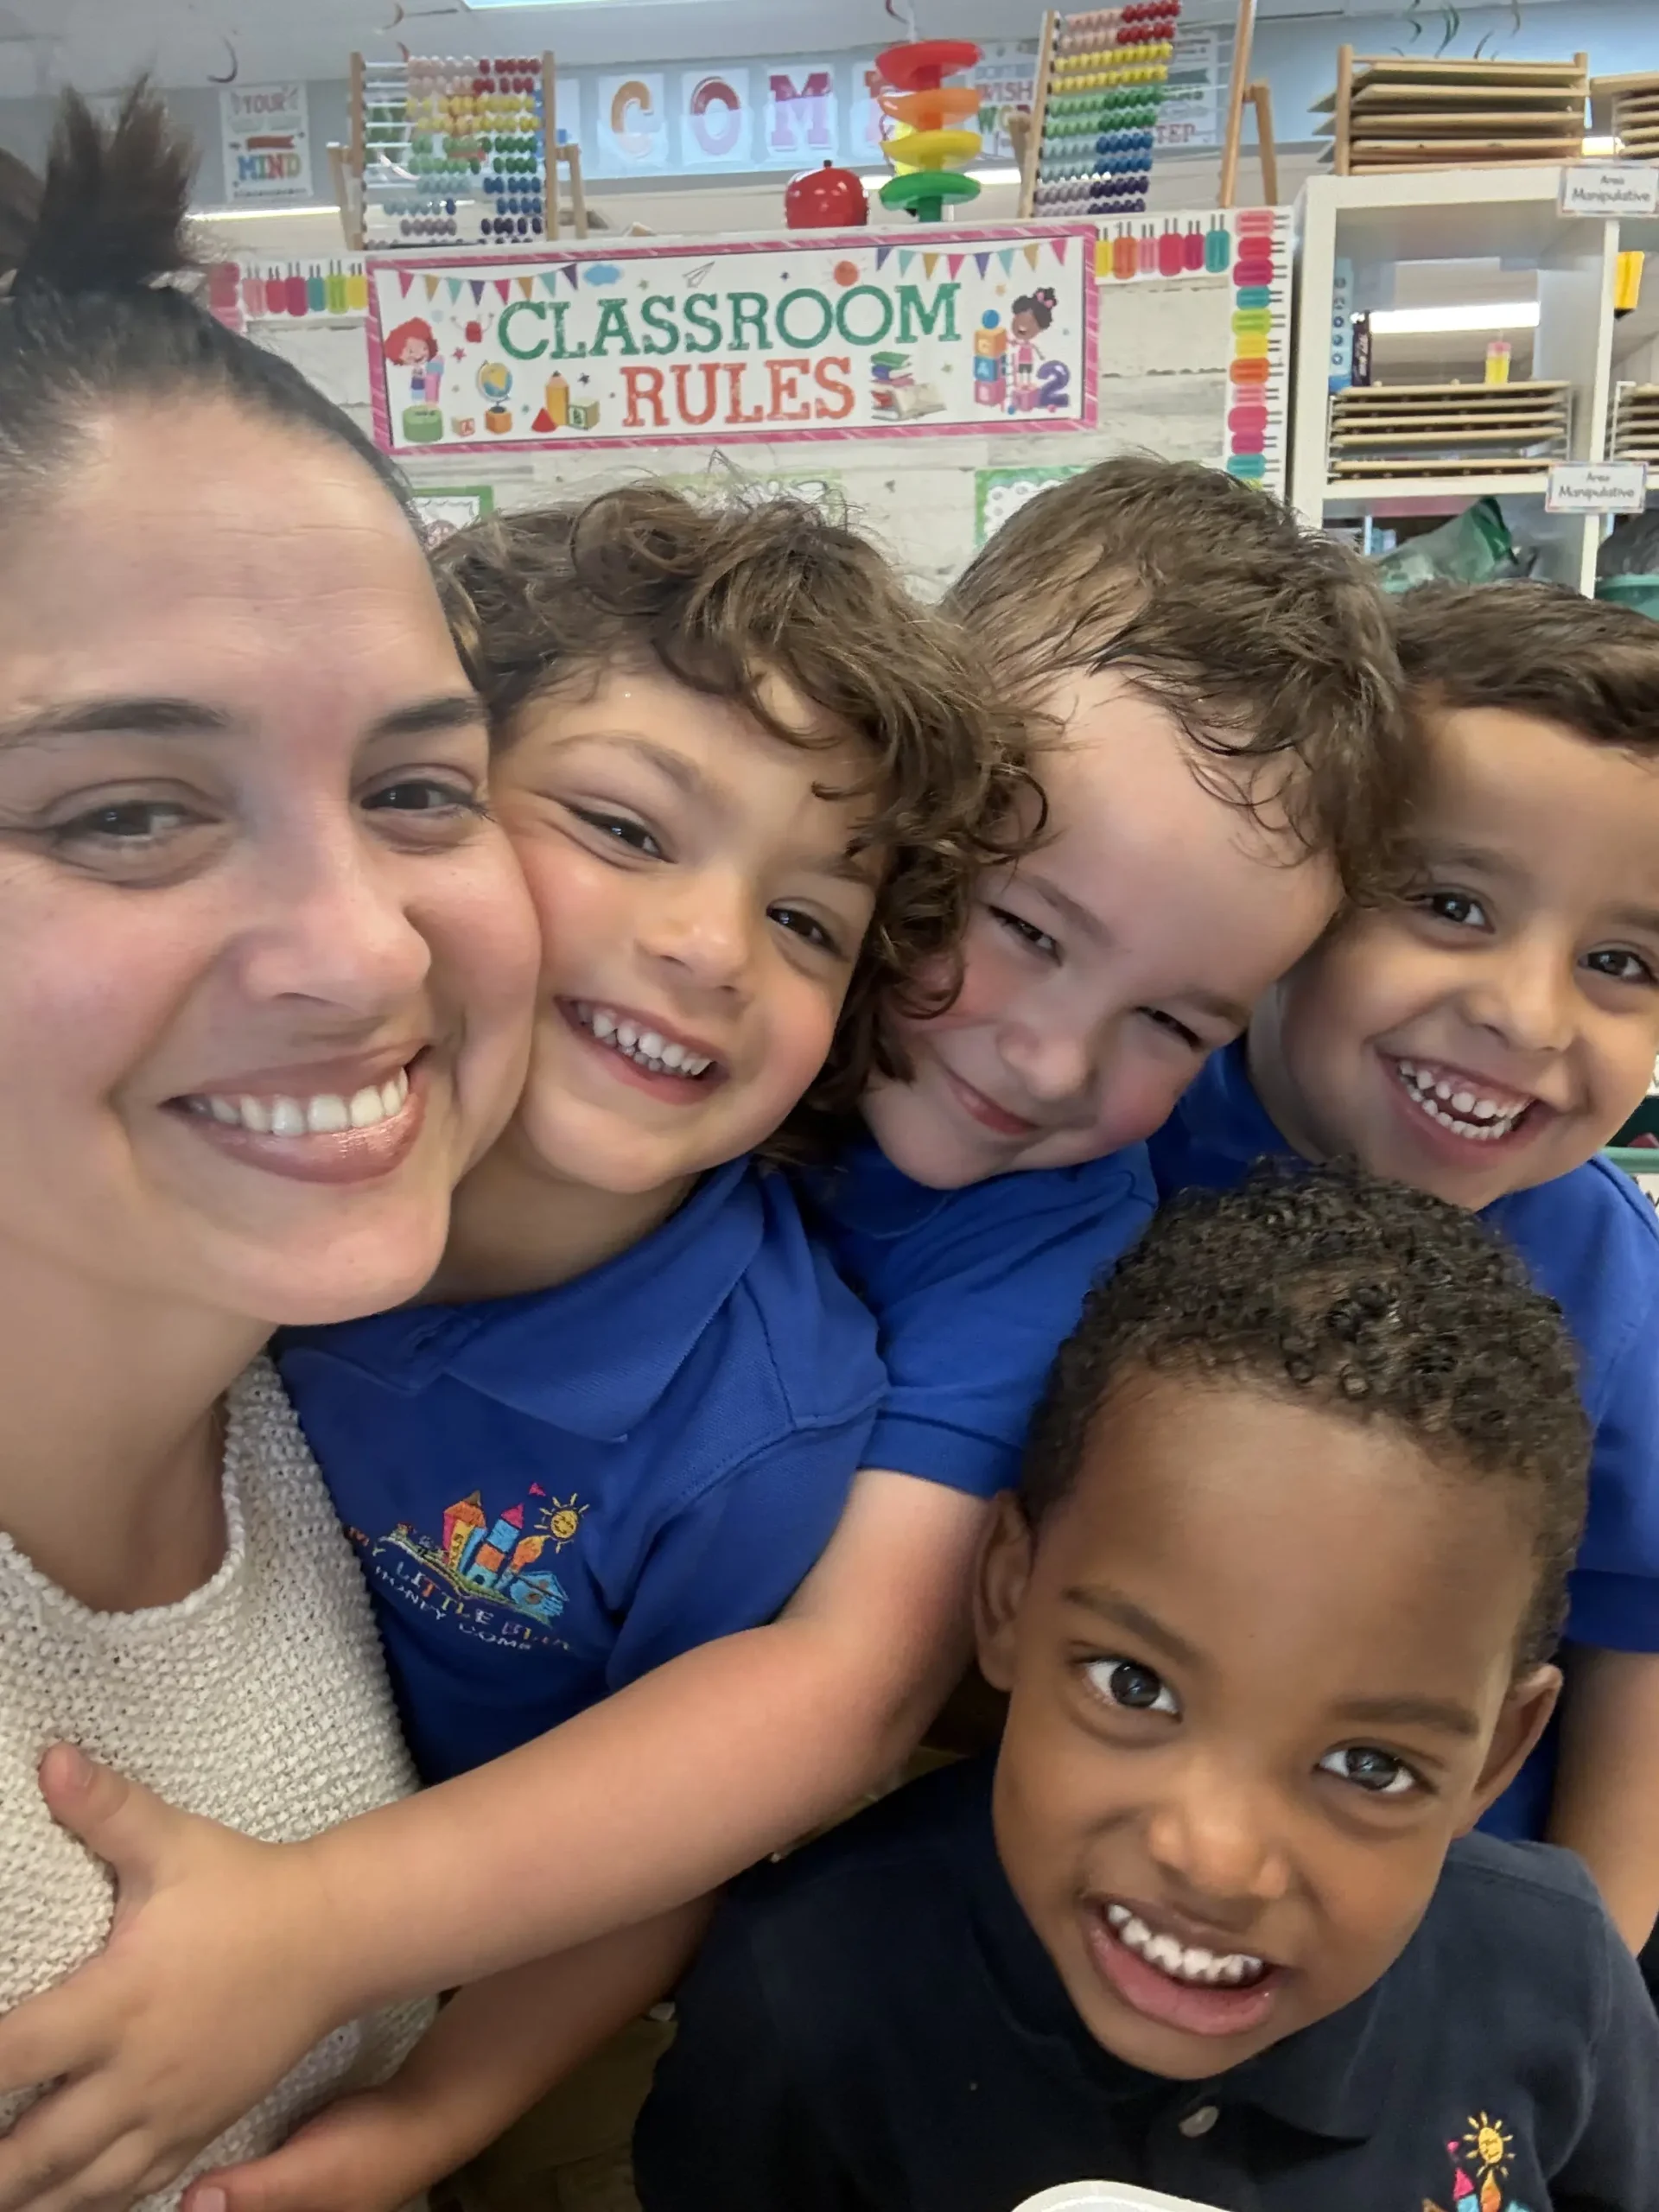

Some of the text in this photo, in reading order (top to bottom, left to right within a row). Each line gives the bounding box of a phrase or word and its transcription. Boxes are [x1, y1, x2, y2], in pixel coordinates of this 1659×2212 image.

[236, 153, 302, 181] MIND
[498, 283, 963, 360] CLASSROOM
[620, 356, 856, 428] RULES
[1036, 359, 1070, 408] 2
